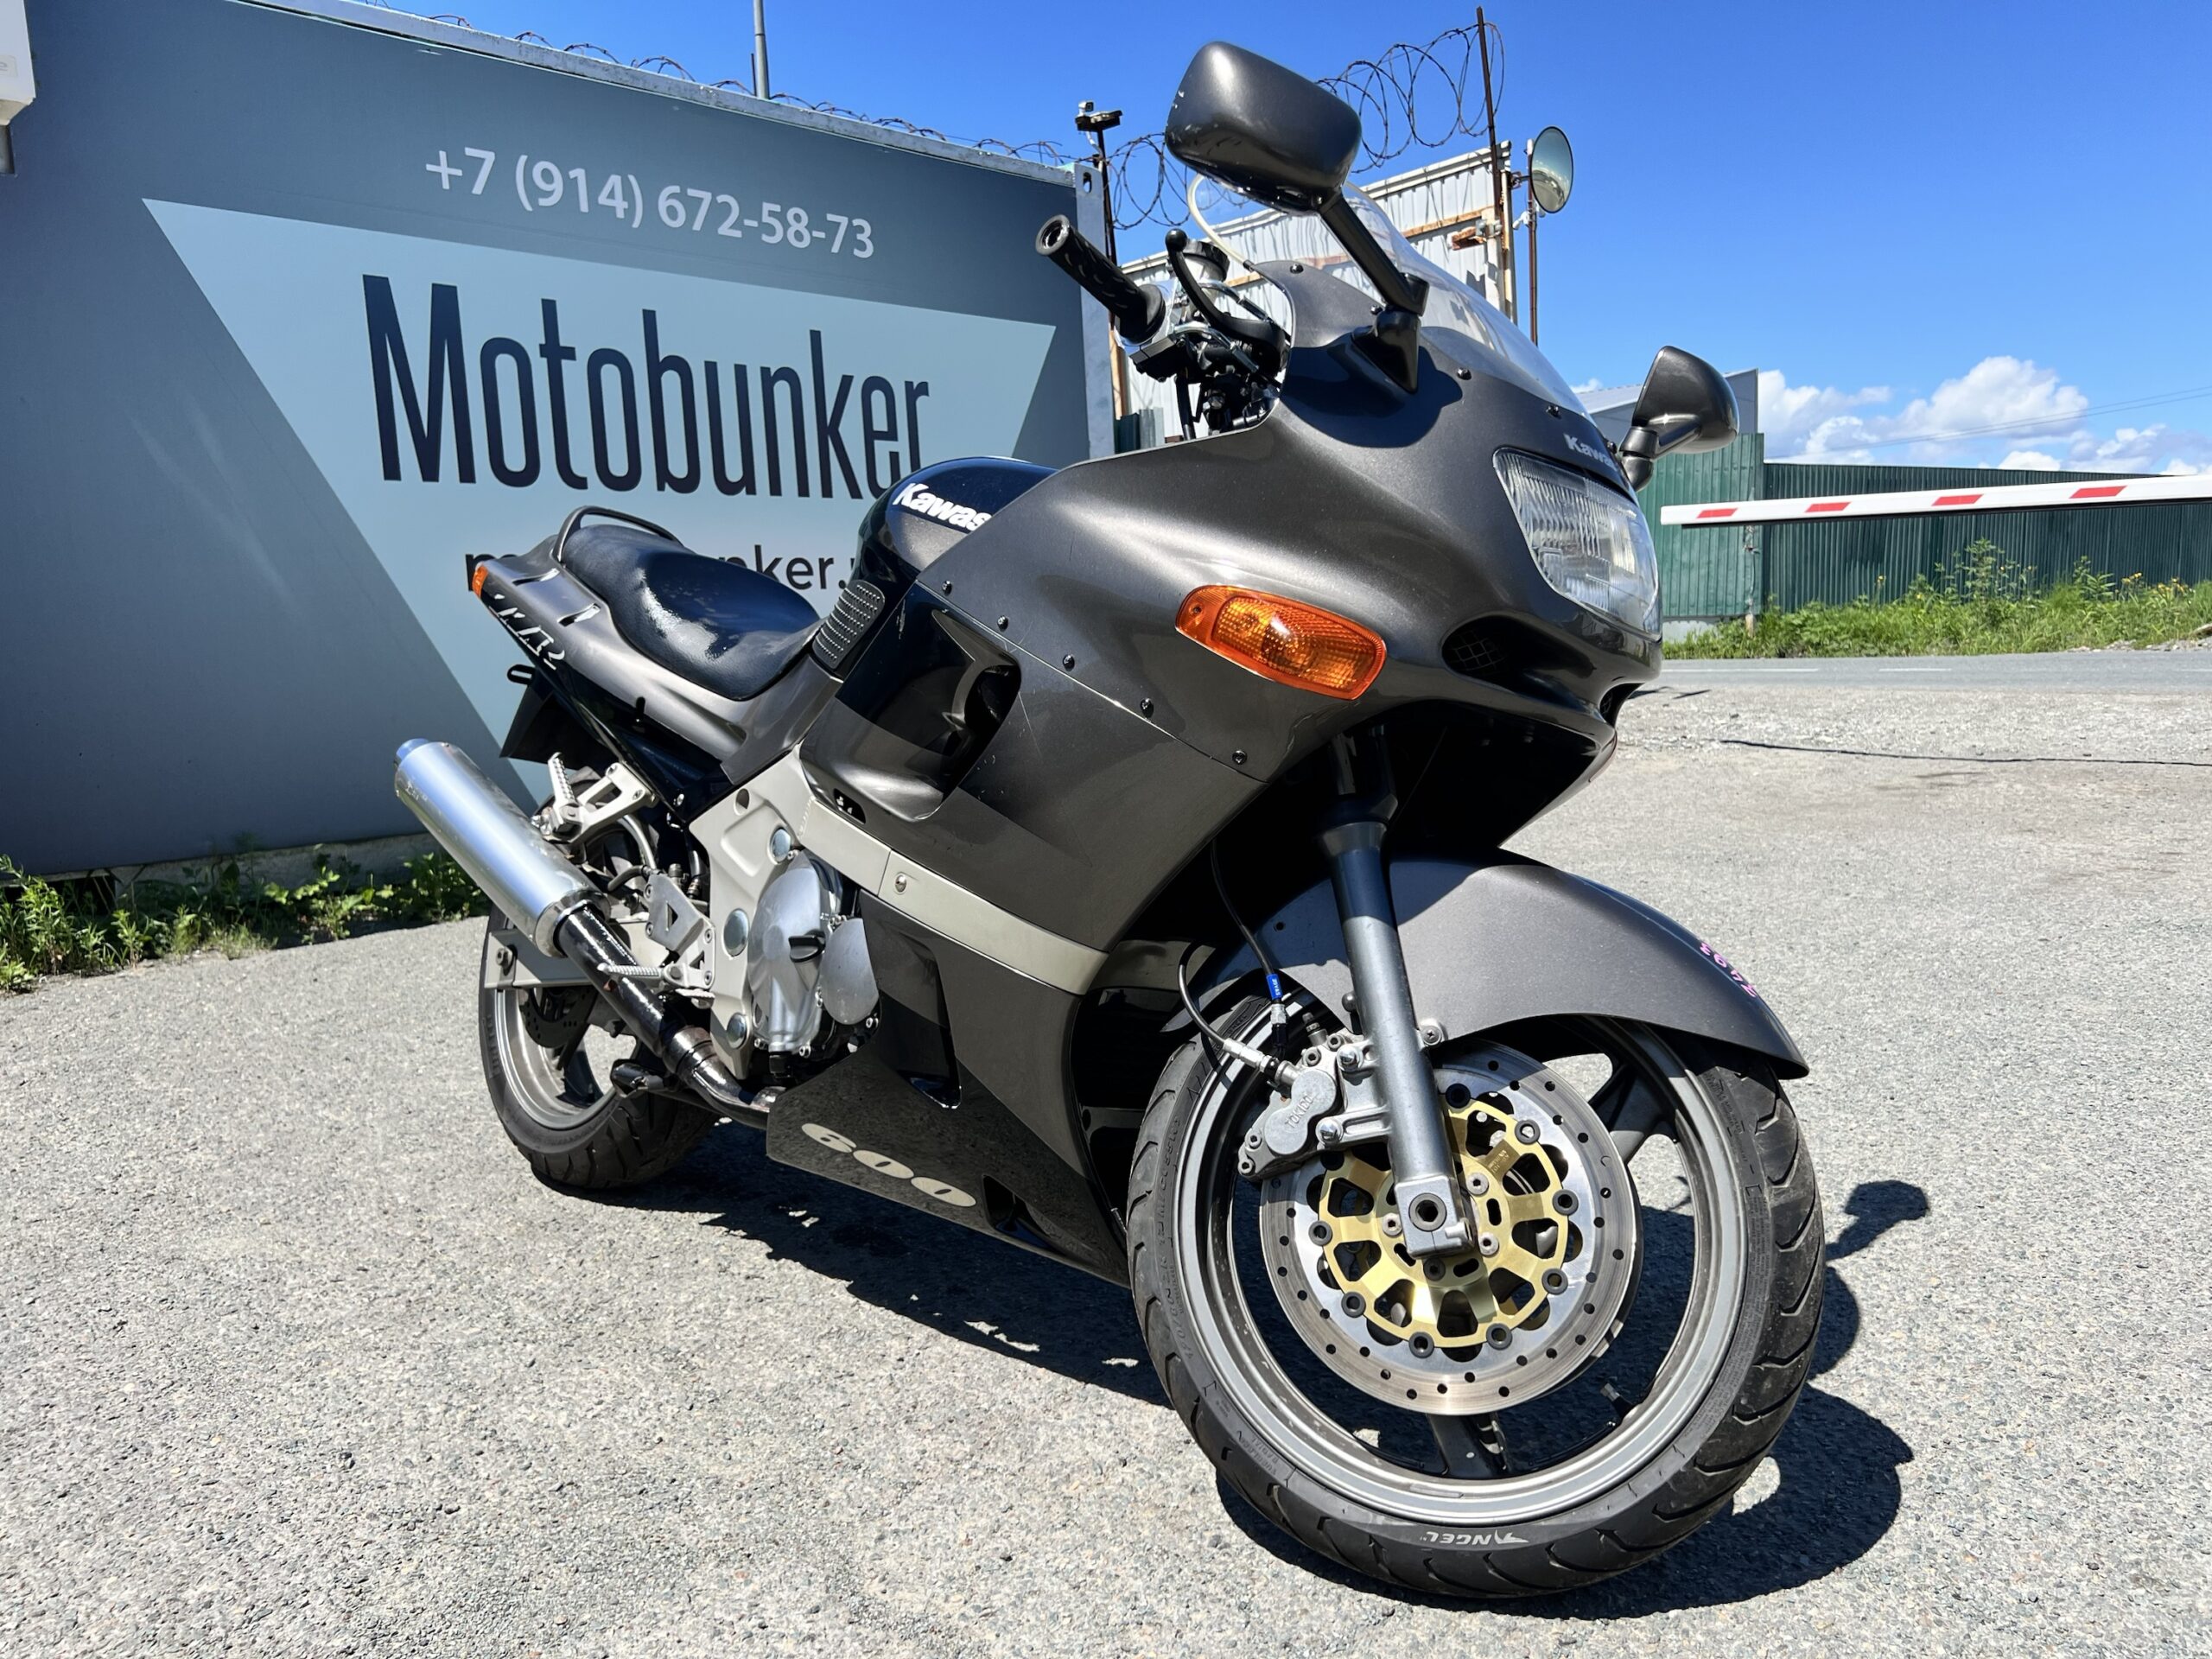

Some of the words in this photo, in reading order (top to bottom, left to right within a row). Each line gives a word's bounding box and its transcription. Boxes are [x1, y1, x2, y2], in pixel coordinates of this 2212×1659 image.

[426, 146, 495, 195] +7
[517, 155, 644, 228] (914)
[658, 185, 874, 258] 672-58-73
[363, 274, 929, 499] Motobunker
[802, 1123, 976, 1207] 600
